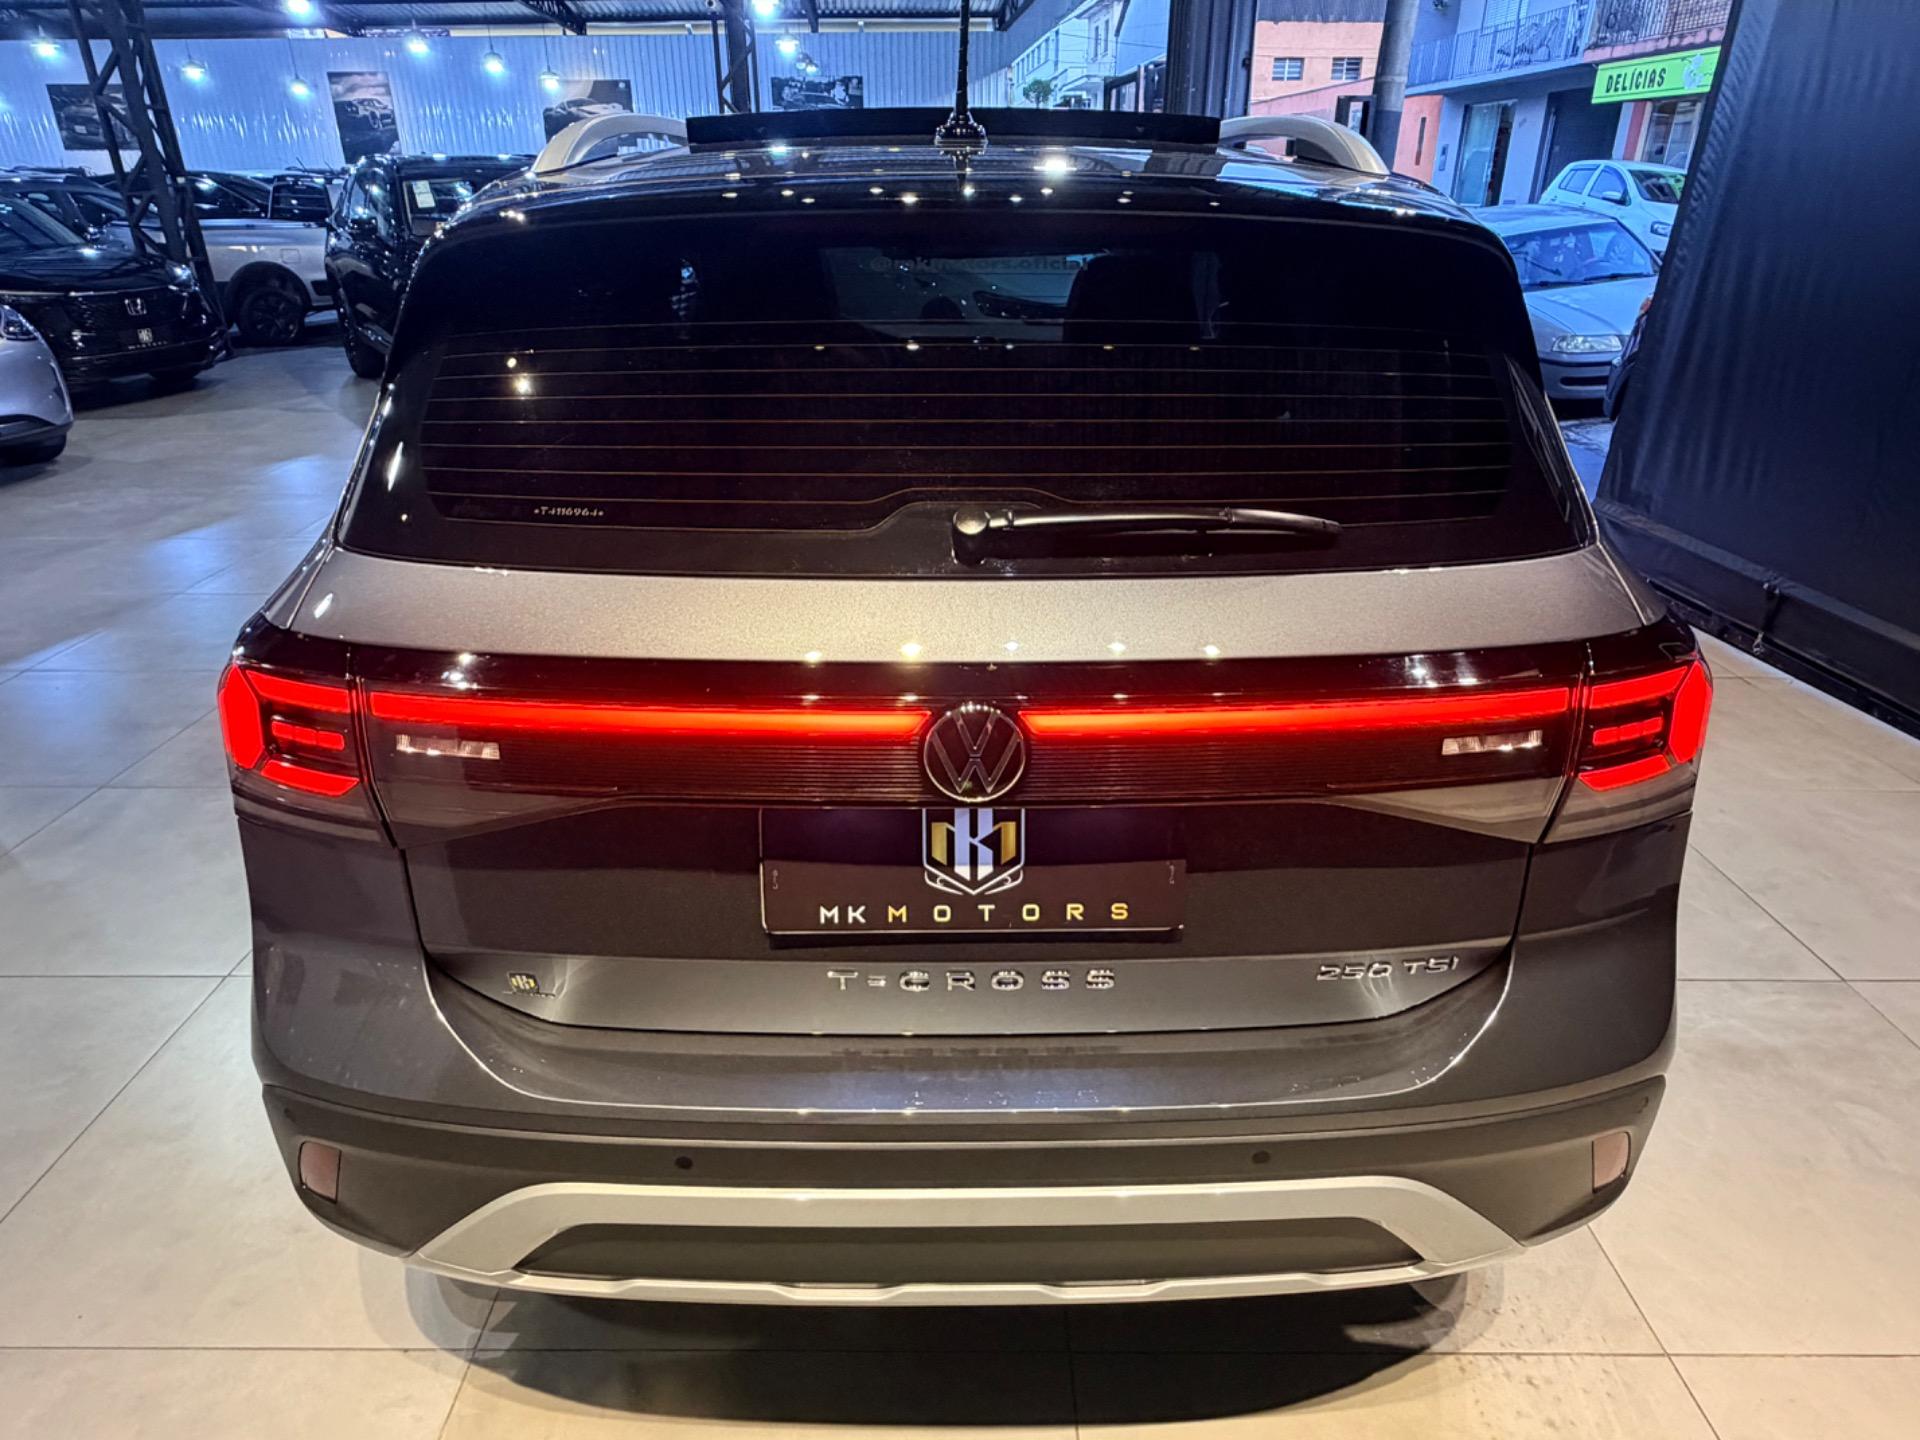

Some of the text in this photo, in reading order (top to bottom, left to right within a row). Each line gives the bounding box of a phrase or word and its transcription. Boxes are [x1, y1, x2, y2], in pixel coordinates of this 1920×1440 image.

[1605, 68, 1667, 93] DELÍCIAS
[826, 968, 1116, 991] T-CROSS
[1316, 956, 1460, 981] 250 TSI
